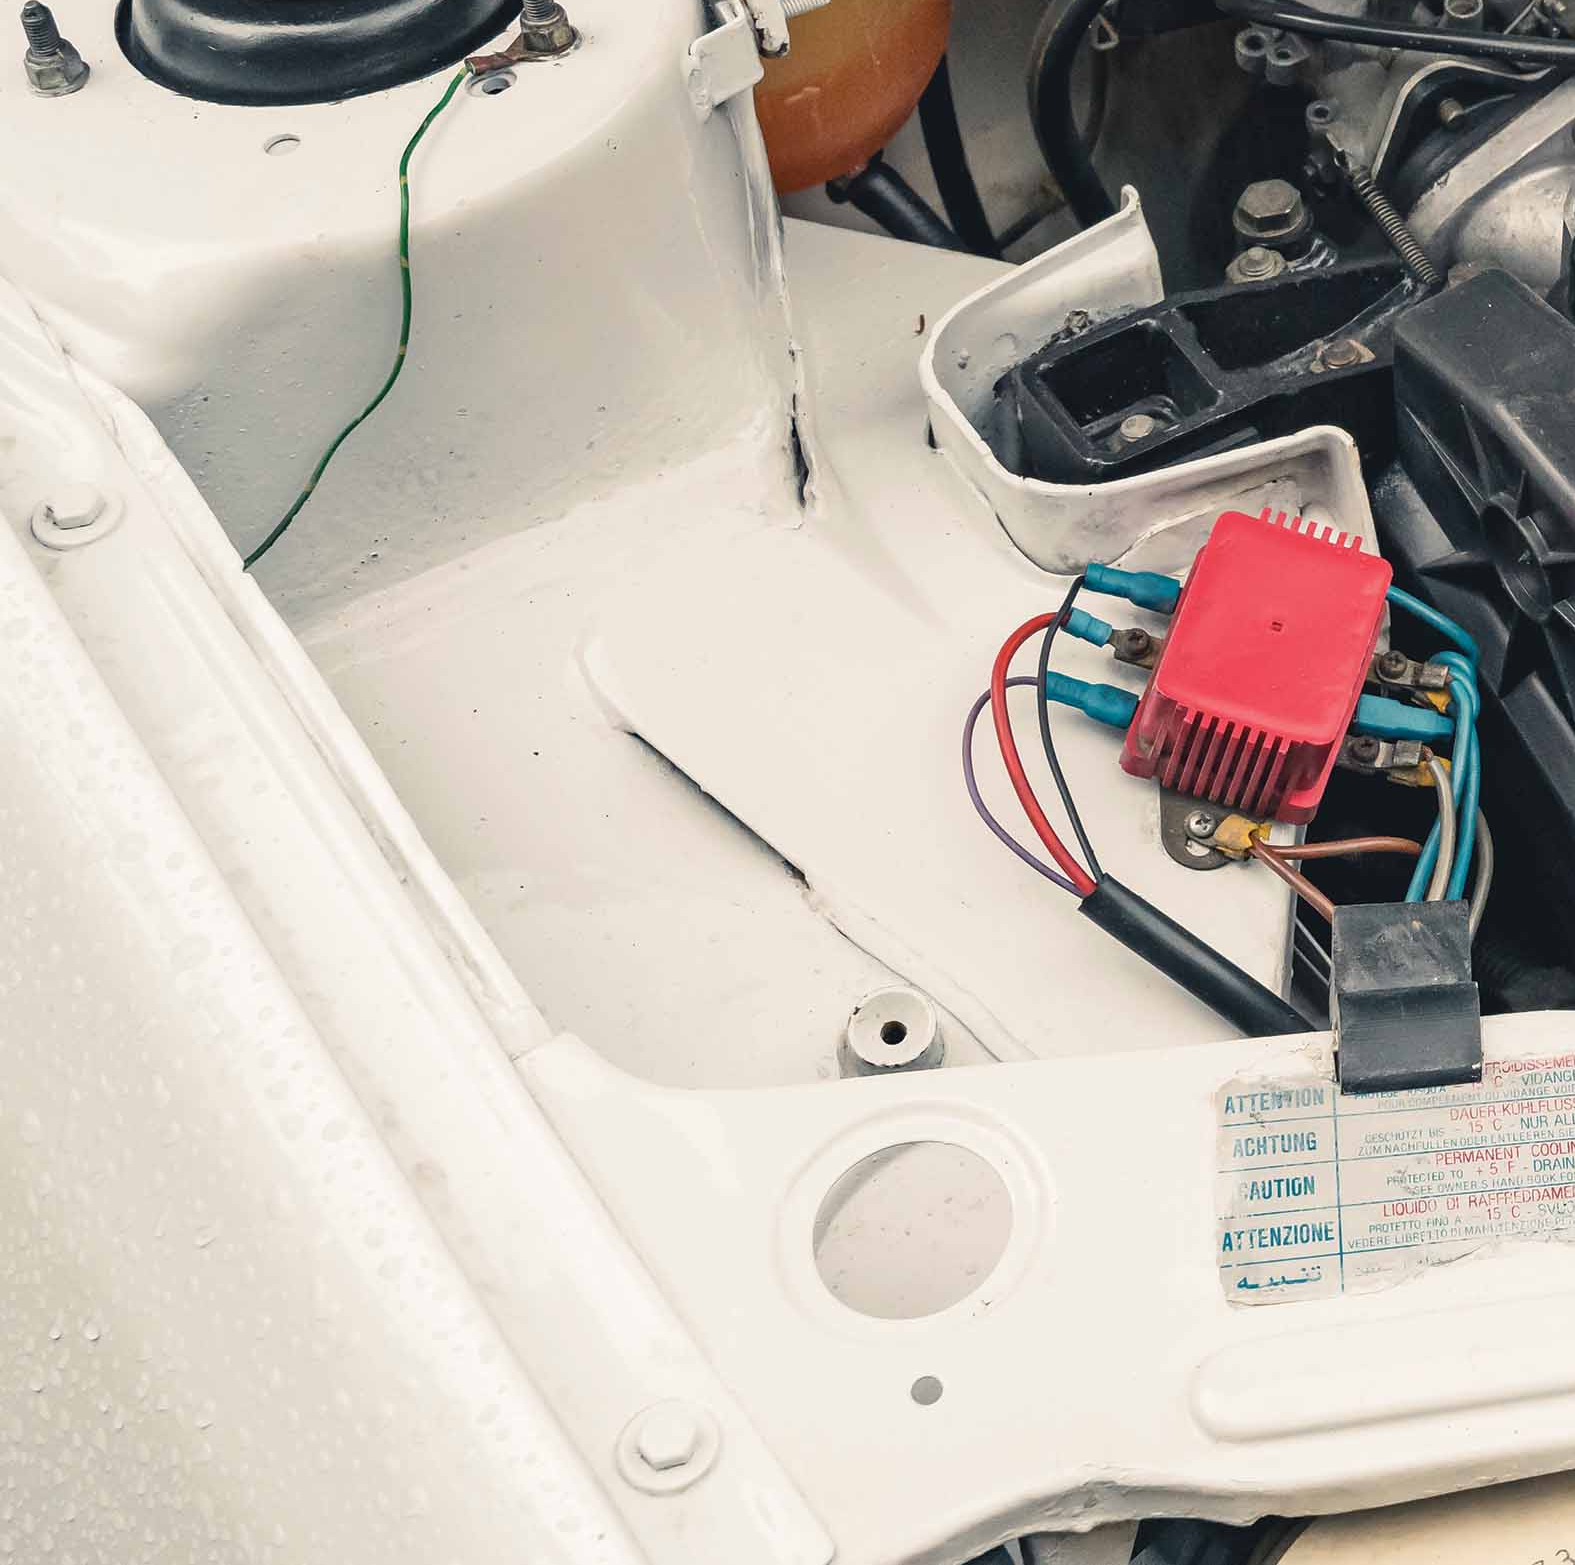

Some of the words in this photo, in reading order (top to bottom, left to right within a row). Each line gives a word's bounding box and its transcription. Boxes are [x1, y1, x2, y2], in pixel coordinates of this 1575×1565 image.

[1224, 1087, 1325, 1115] ATTENTION
[1470, 1121, 1484, 1133] 15
[1493, 1119, 1503, 1132] C
[1520, 1116, 1549, 1130] NUR
[1233, 1131, 1318, 1159] ACHTUNG
[1357, 1144, 1382, 1157] ZUM
[1435, 1145, 1521, 1166] PERMANENT
[1386, 1172, 1445, 1186] PROTECTED
[1451, 1169, 1464, 1179] TO
[1489, 1162, 1499, 1176] 5
[1507, 1160, 1516, 1173] F
[1533, 1156, 1575, 1172] DRAIN
[1368, 1219, 1422, 1234] PROTETTO
[1487, 1207, 1501, 1221] 15
[1511, 1205, 1521, 1219] C
[1383, 1198, 1438, 1218] LIQUIDO
[1446, 1197, 1460, 1211] DI
[1221, 1221, 1335, 1253] ATTENZIONE
[1349, 1235, 1391, 1250] VEDERE
